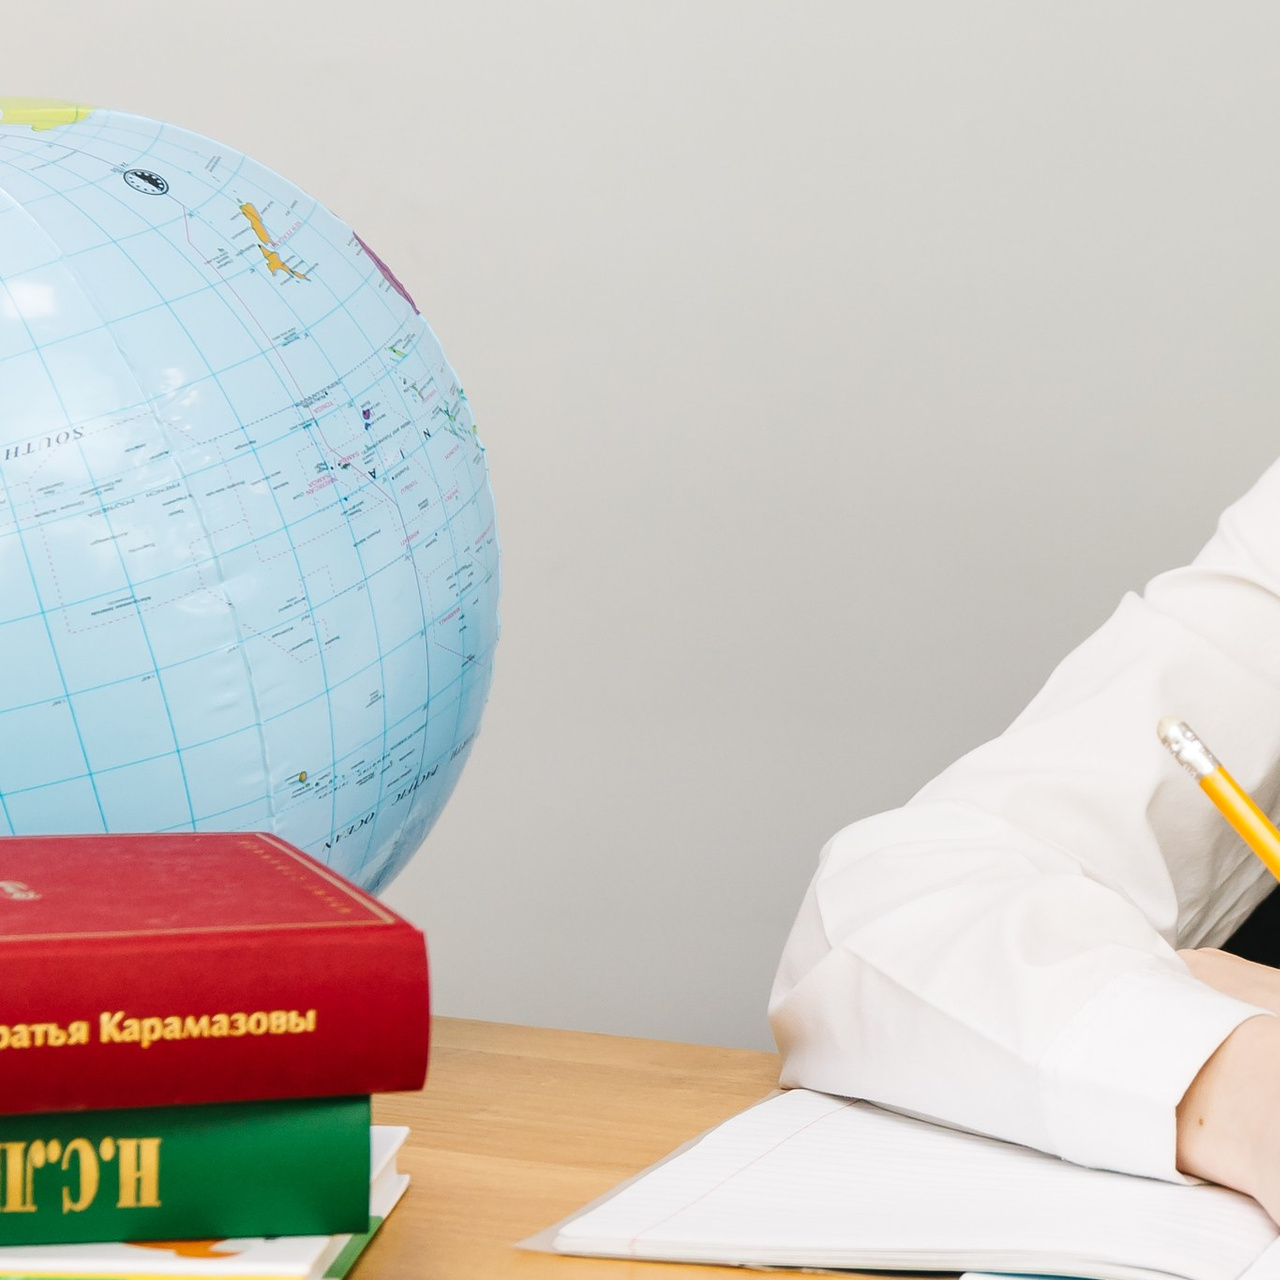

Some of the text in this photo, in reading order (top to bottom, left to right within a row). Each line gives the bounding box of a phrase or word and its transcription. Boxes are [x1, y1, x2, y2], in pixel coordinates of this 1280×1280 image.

[4, 425, 84, 460] SOUTH
[322, 812, 376, 852] OCEAN
[99, 1008, 318, 1049] Карамазовы
